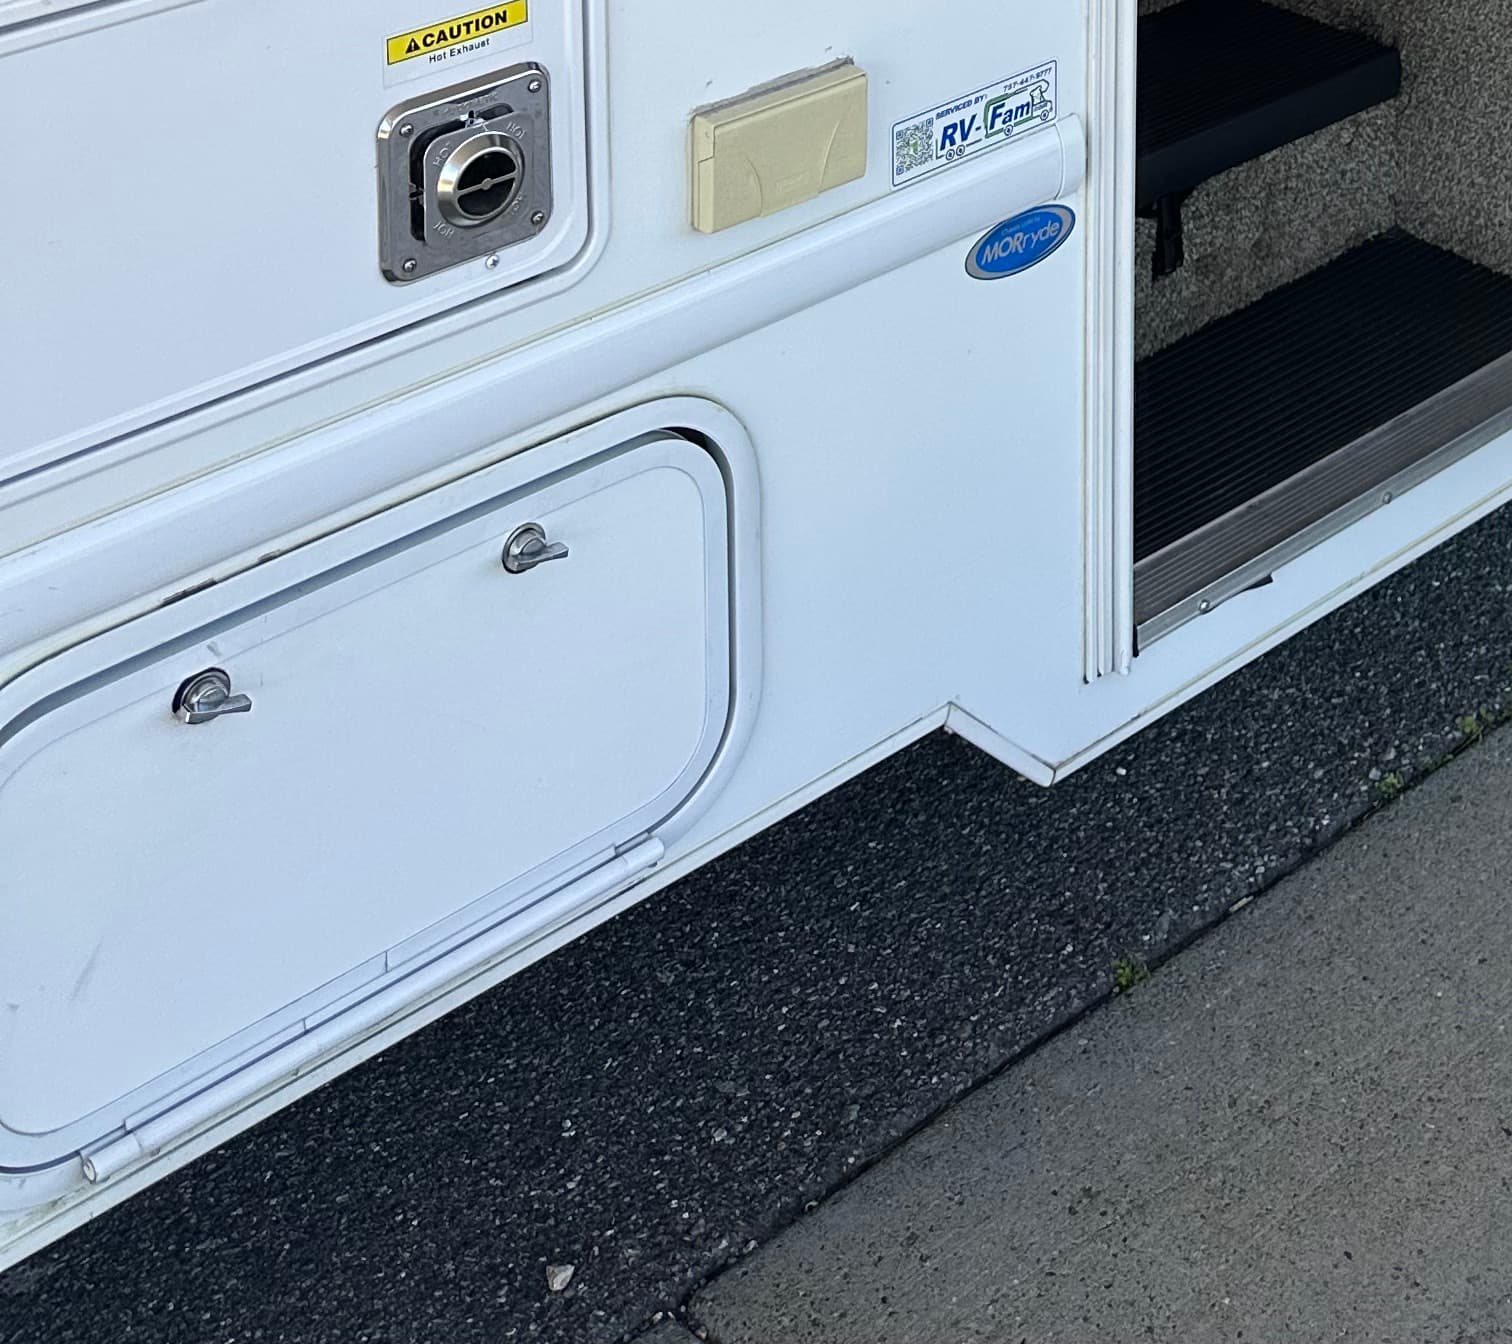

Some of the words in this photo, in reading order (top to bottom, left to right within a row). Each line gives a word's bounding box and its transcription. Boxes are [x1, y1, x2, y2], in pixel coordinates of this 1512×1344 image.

[422, 10, 507, 47] CAUTION
[429, 52, 447, 63] Hot
[450, 38, 490, 58] Exhaust
[935, 99, 973, 120] SERVICED
[981, 219, 1060, 266] MORryde
